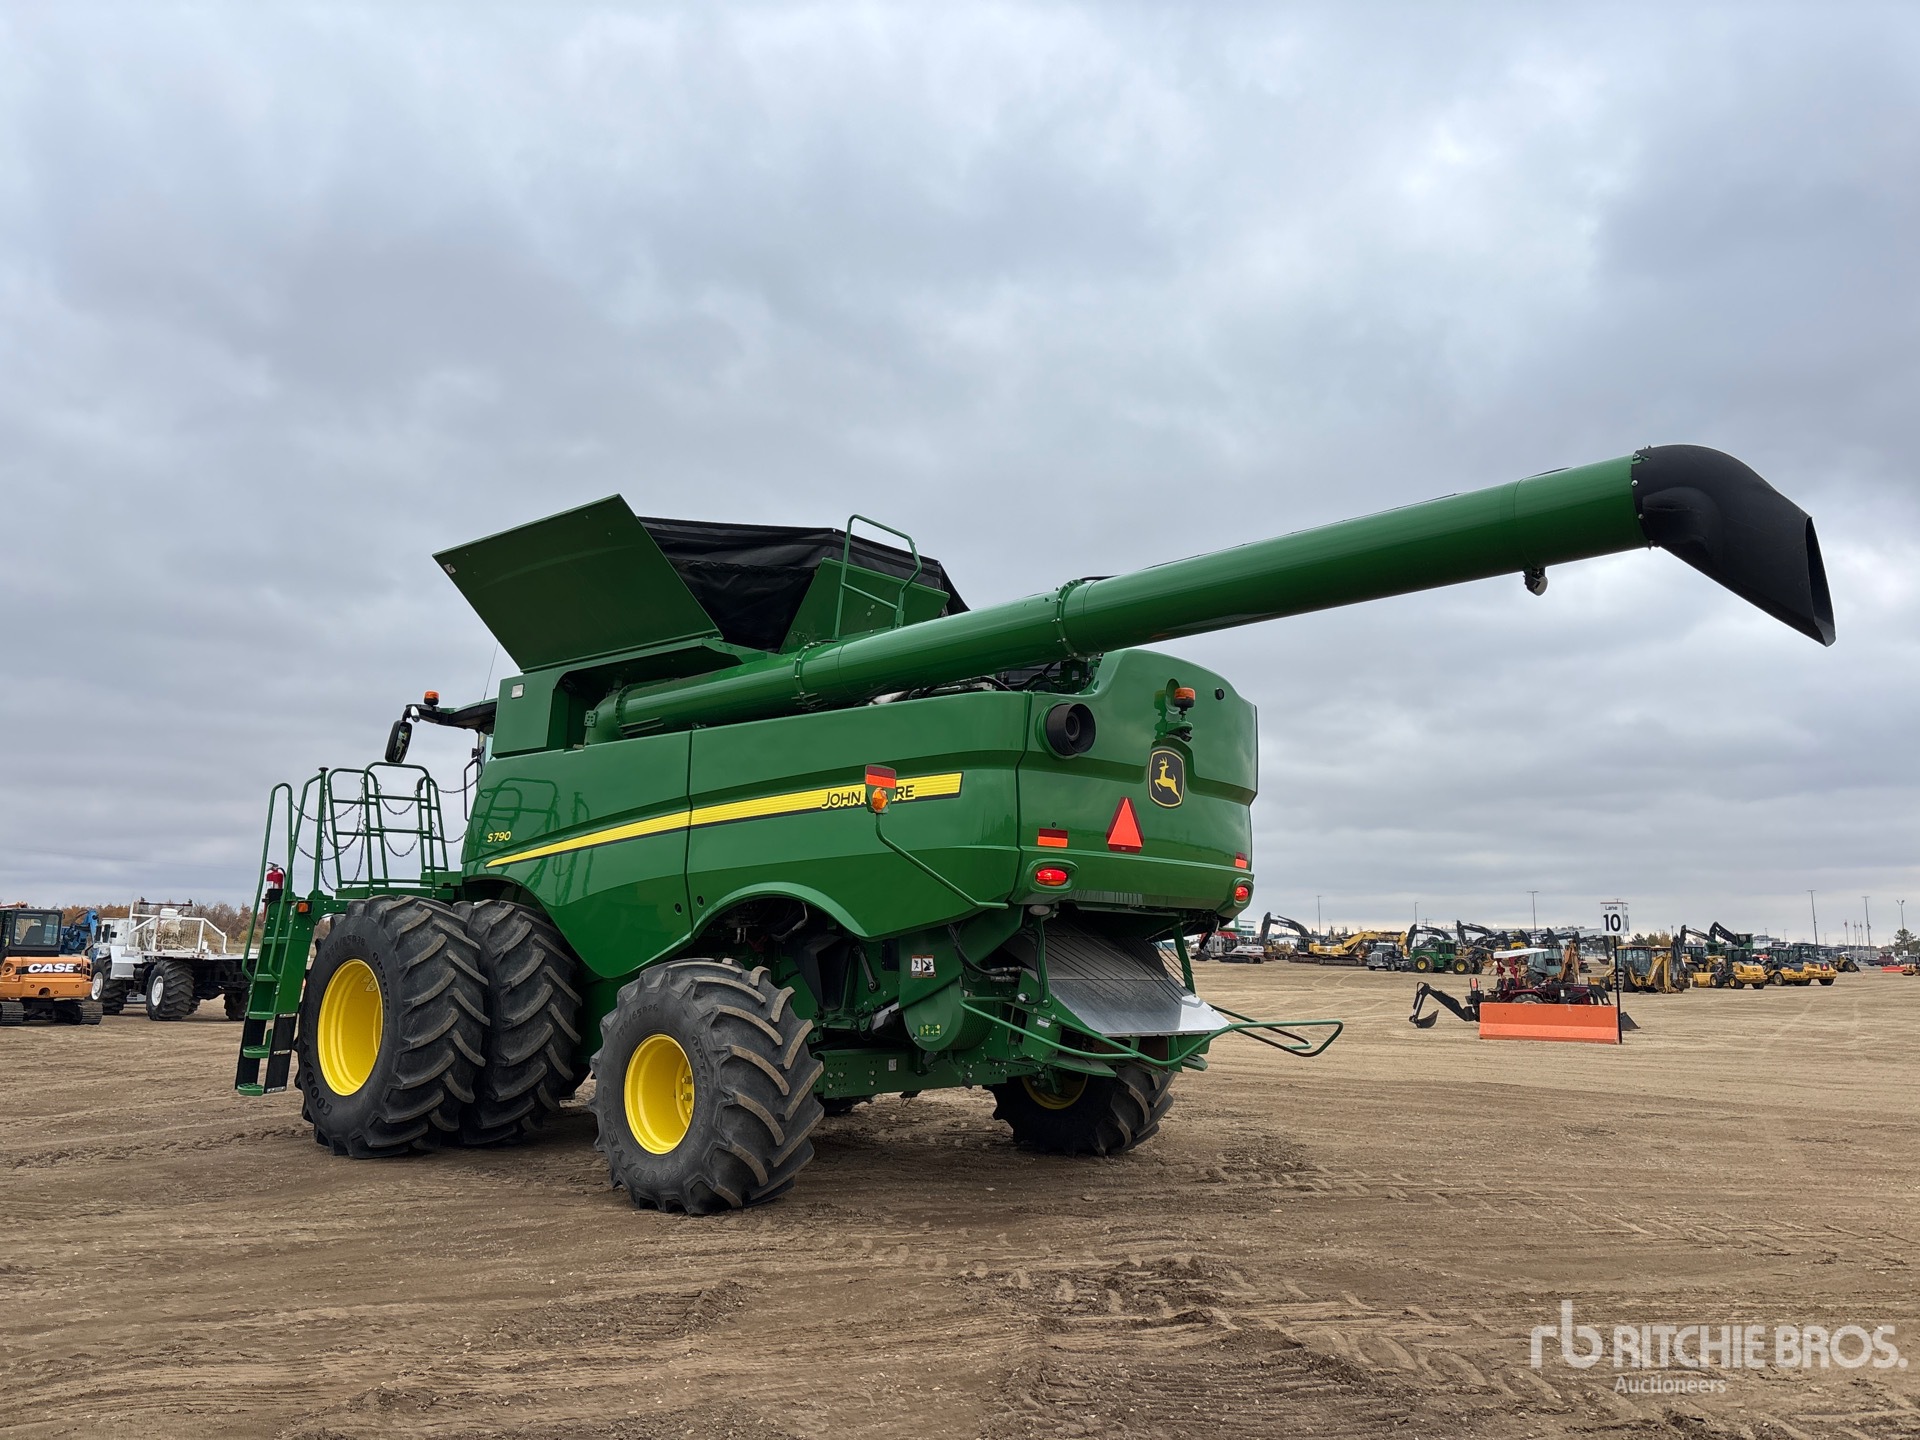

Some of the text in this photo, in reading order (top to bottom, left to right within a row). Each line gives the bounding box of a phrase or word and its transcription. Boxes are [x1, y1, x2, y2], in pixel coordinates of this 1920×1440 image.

[822, 790, 861, 807] JOHN
[487, 831, 511, 843] S790
[1603, 913, 1621, 932] 10
[28, 963, 76, 974] CASE
